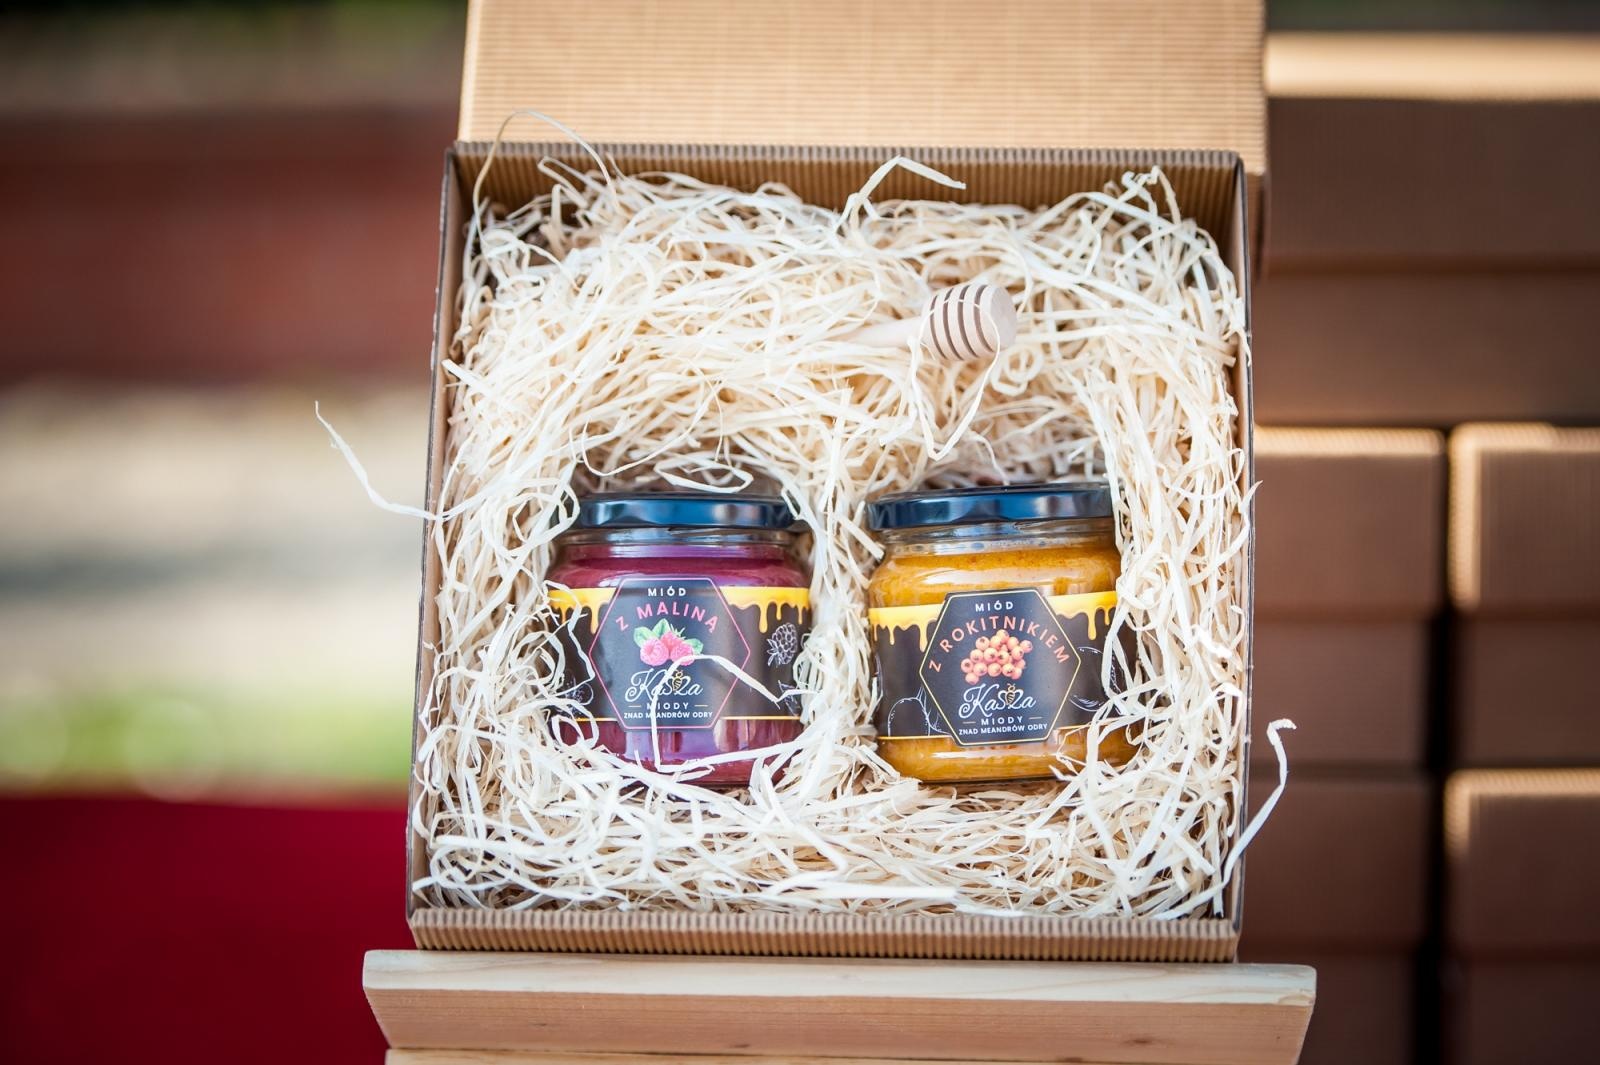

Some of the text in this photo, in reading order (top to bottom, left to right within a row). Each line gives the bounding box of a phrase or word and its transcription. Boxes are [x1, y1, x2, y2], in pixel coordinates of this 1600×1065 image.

[647, 585, 687, 597] MIÓD
[975, 600, 1015, 612] MIÓD
[615, 601, 720, 633] Z MALINĄ
[928, 615, 1070, 673] Z ROKITNIKIEM
[645, 710, 690, 719] MANDRÓW
[692, 711, 713, 719] ODRY
[980, 716, 1023, 726] MIODY
[958, 723, 1048, 736] ZNAD MEANDRÓW ODRY
